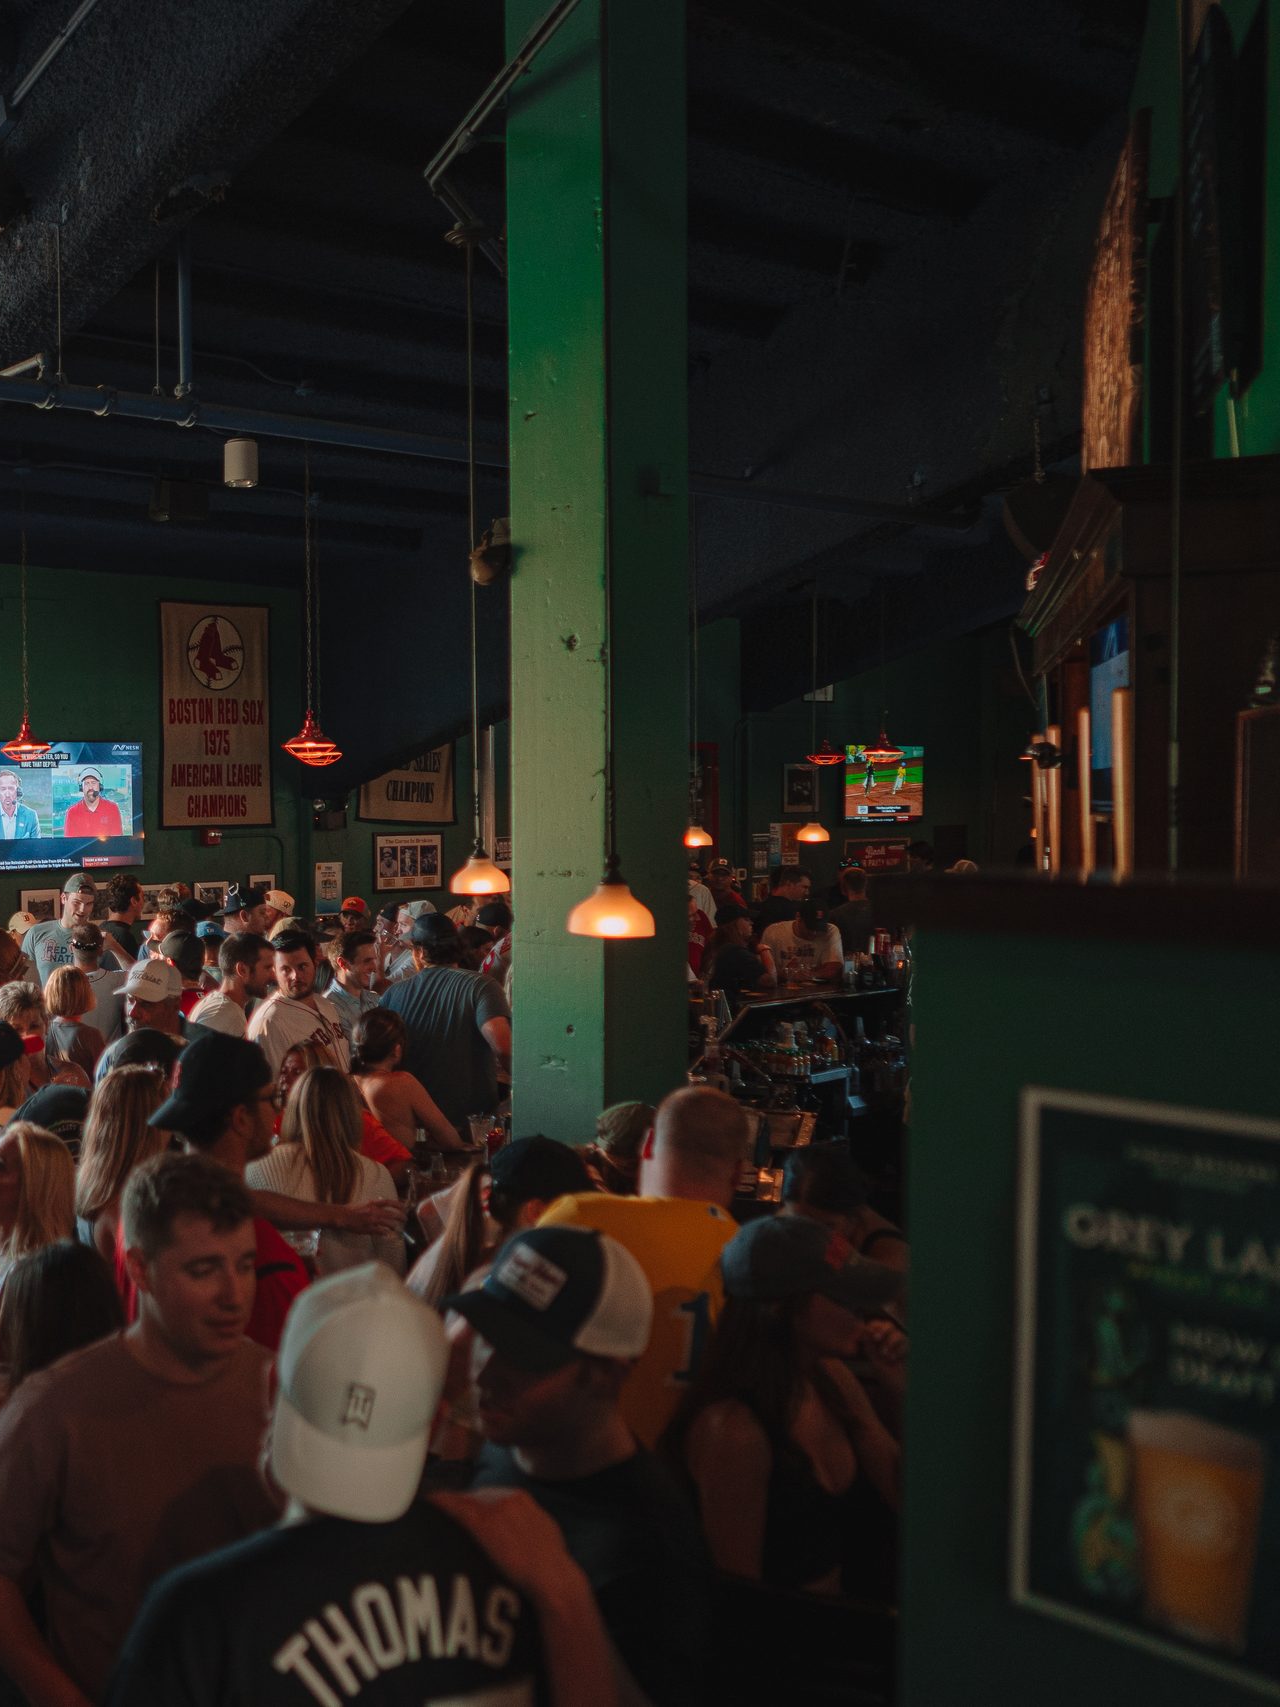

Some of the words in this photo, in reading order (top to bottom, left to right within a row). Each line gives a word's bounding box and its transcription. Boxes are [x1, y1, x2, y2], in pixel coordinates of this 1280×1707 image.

[169, 698, 213, 724] BOSTON
[218, 698, 238, 725] RED
[242, 699, 264, 725] SOX
[203, 730, 230, 755] 1975
[171, 764, 223, 787] AMERICAN
[226, 764, 262, 787] LEAGUE
[386, 780, 434, 803] CHAMPIONS
[187, 794, 247, 818] CHAMPIONS
[47, 946, 68, 954] RED
[50, 954, 73, 963] NATI
[129, 970, 163, 985] Titleist
[1208, 1226, 1280, 1282] LA
[272, 1572, 521, 1707] THOMAS
